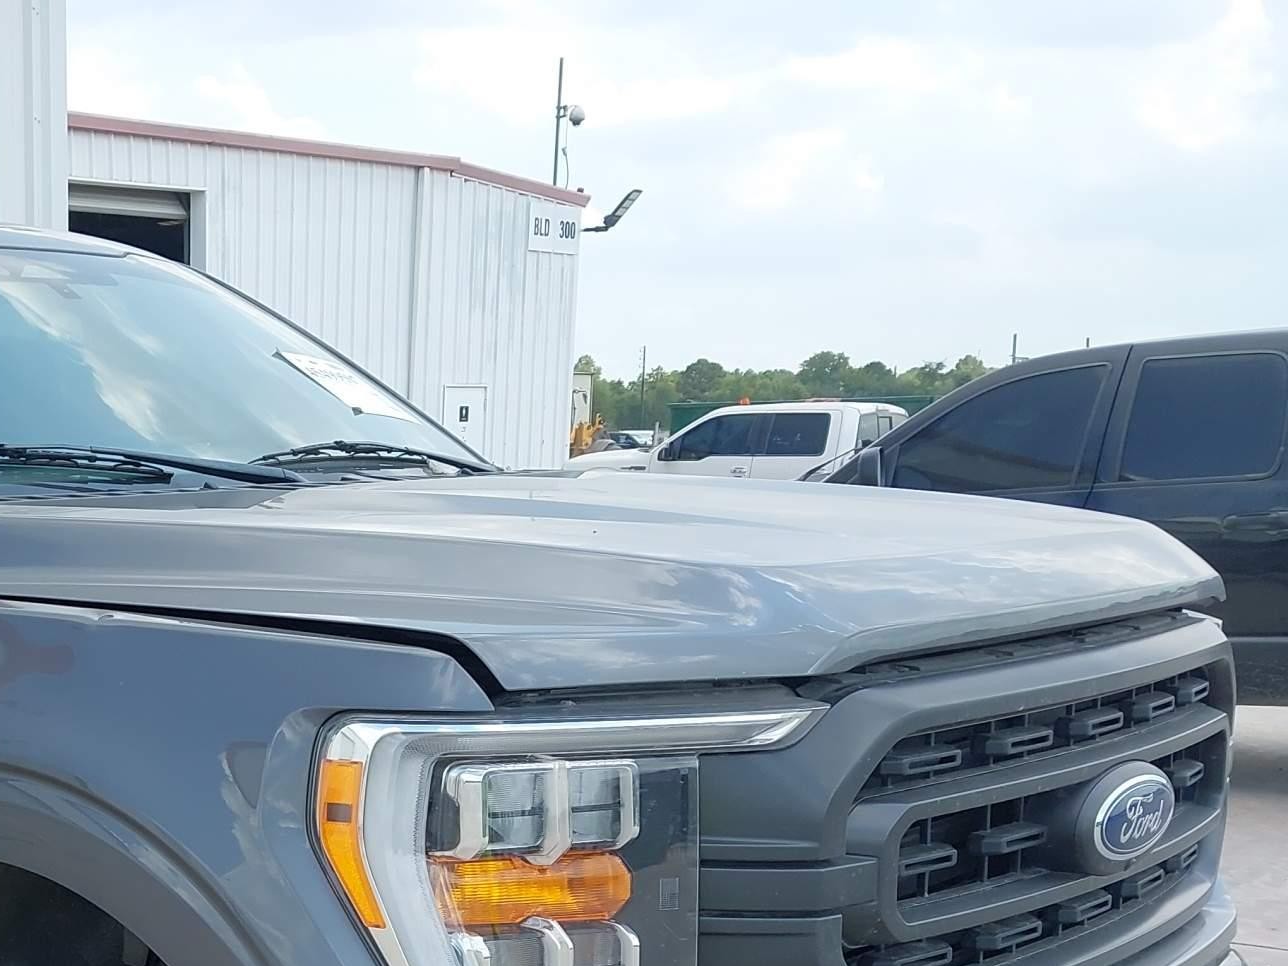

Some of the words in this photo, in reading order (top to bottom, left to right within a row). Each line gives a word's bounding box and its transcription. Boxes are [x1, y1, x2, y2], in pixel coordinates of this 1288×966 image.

[534, 217, 550, 236] BLD
[559, 221, 575, 239] 300
[1120, 793, 1163, 843] Ford
